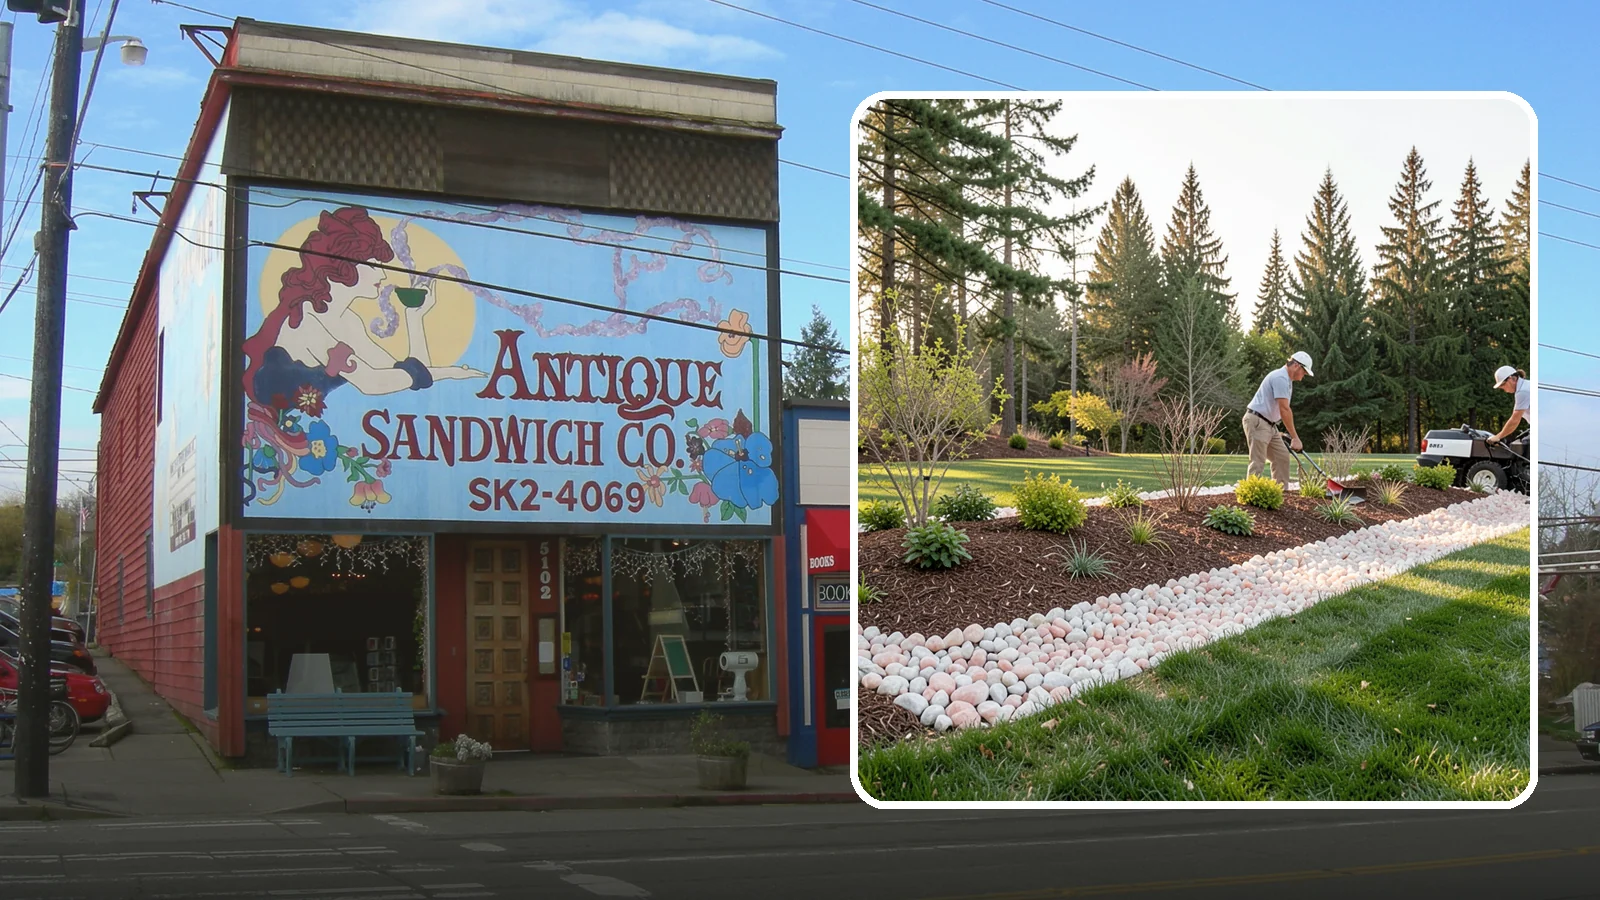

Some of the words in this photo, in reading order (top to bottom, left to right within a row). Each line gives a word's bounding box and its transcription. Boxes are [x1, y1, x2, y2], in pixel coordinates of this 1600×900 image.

[475, 328, 724, 420] ANTIQUE
[361, 408, 604, 468] SANDWICH
[617, 421, 685, 468] CO.
[468, 477, 645, 513] SK2-4069
[540, 541, 551, 600] 5102
[809, 554, 835, 569] BOOKS
